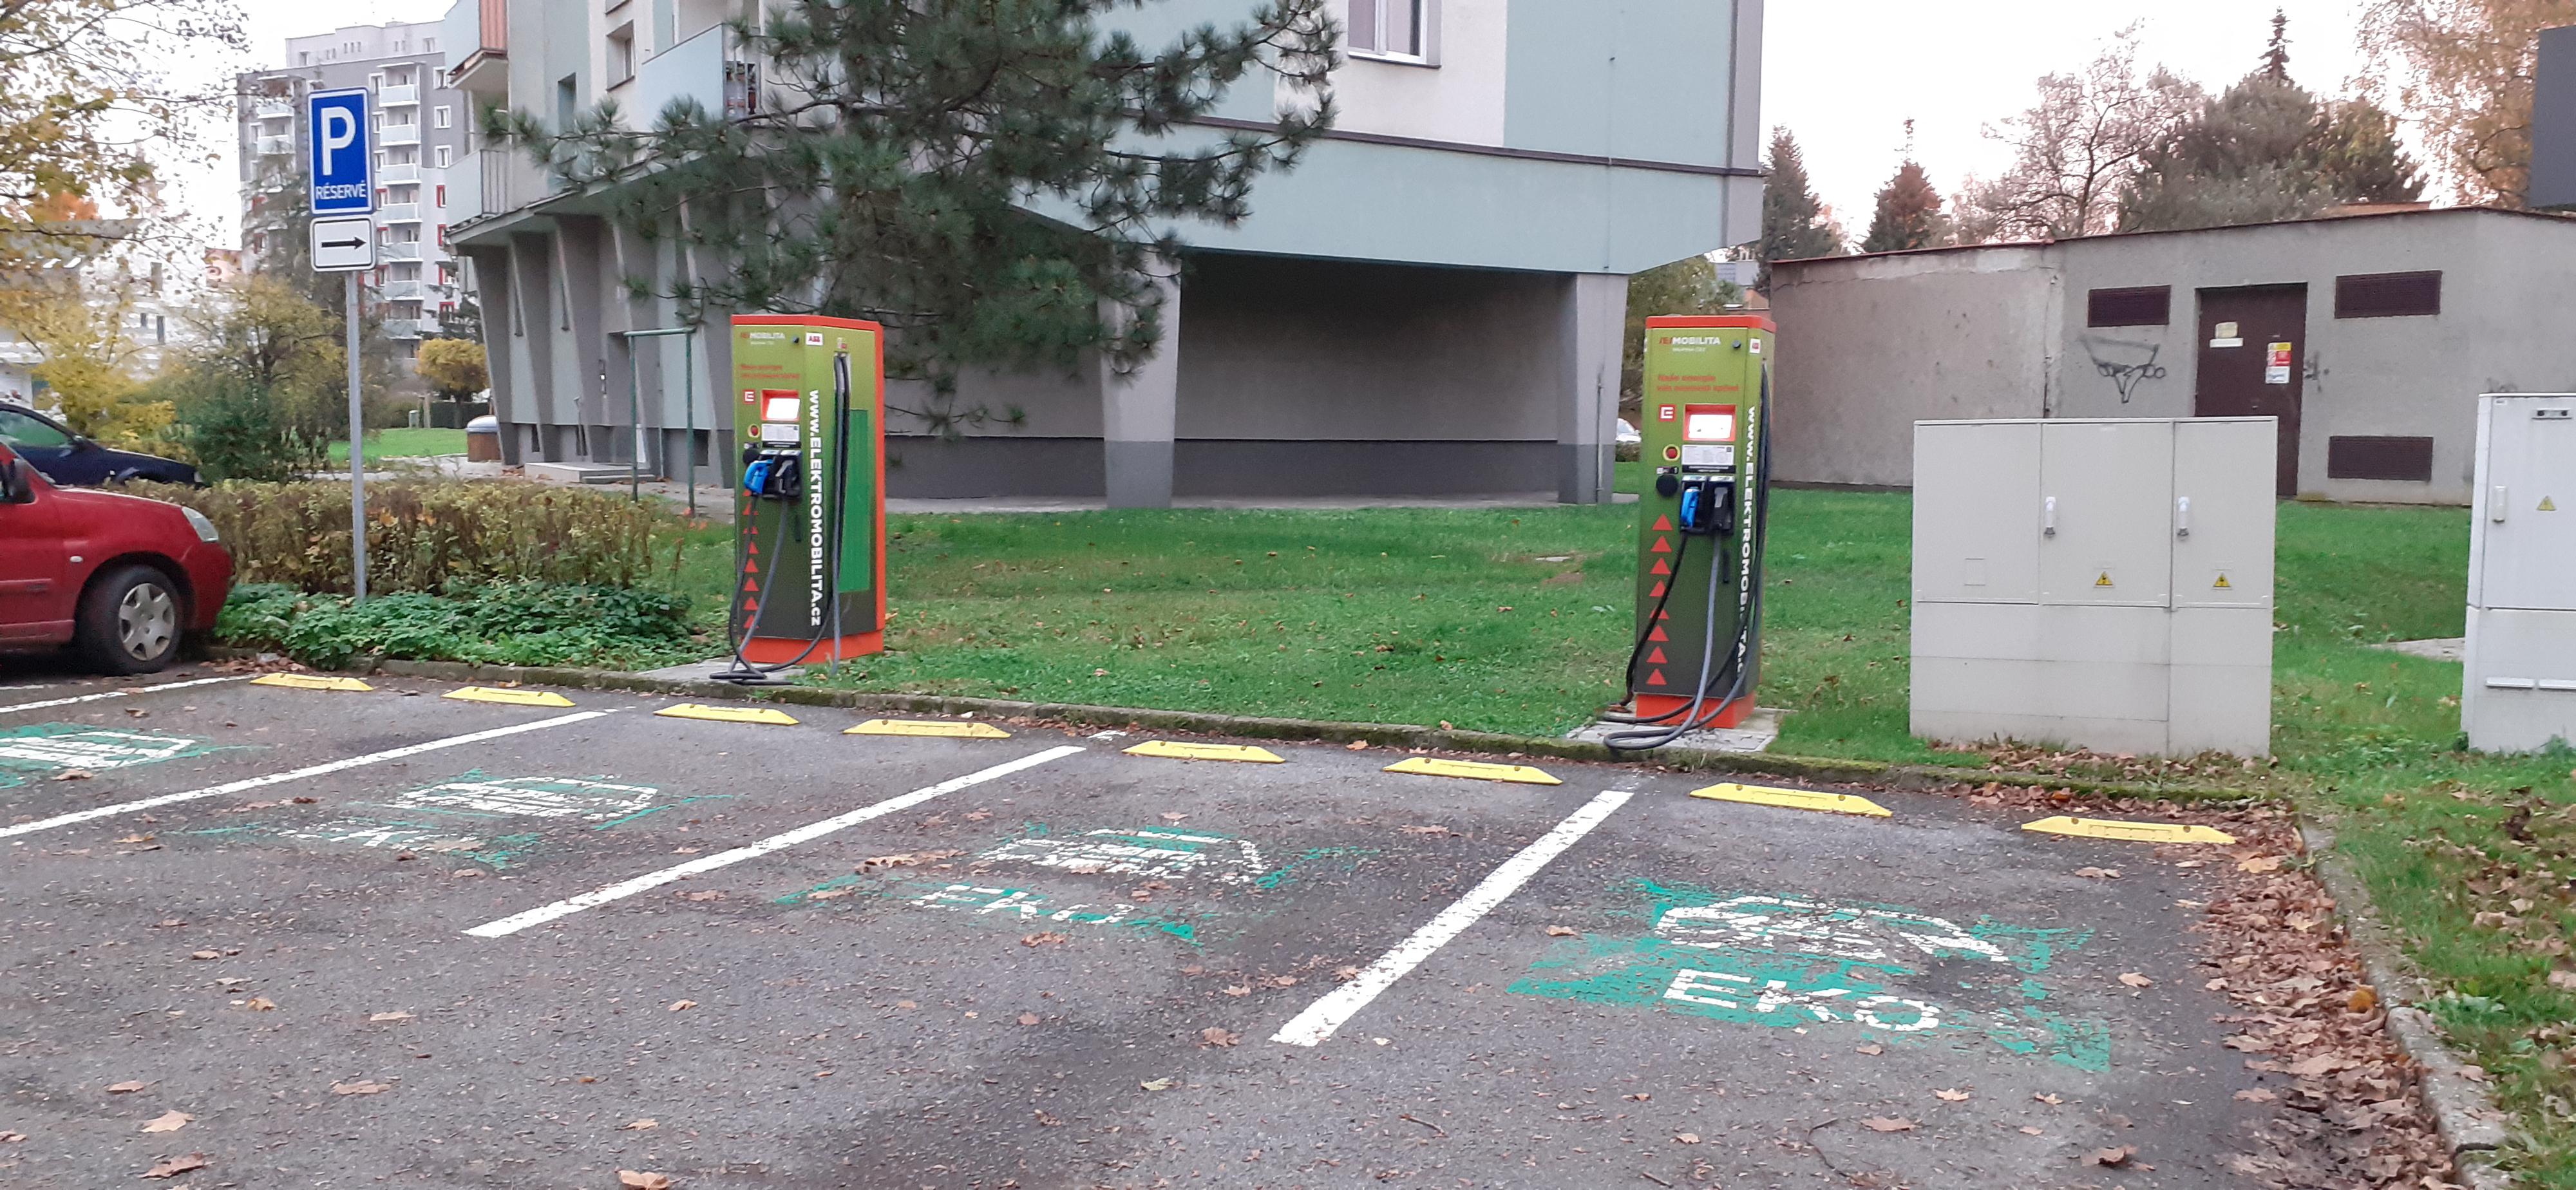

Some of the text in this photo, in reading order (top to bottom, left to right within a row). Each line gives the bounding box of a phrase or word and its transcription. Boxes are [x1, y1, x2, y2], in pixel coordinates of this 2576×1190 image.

[321, 106, 356, 176] P
[316, 180, 366, 200] RÉSERVÉ
[1663, 968, 1941, 1032] EKO
